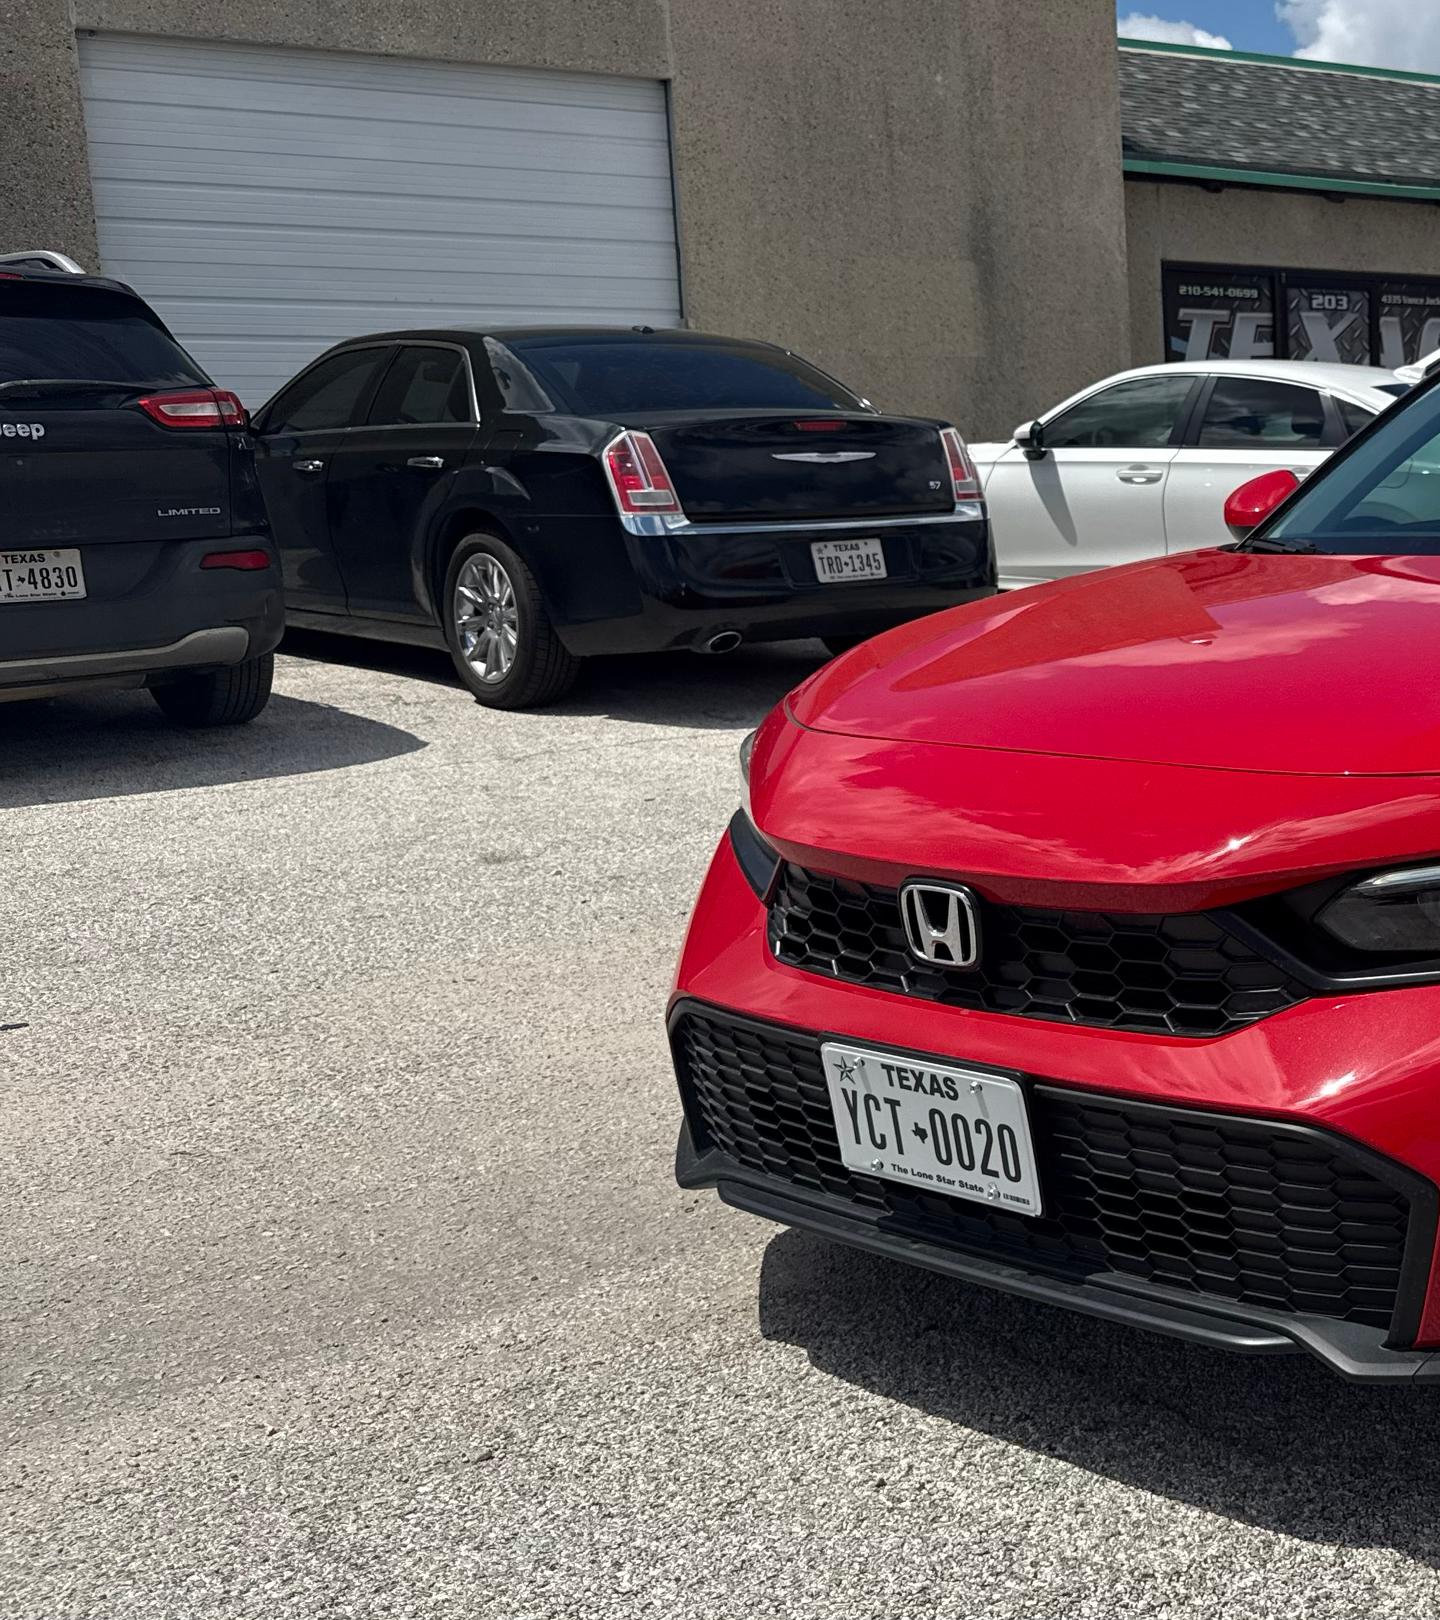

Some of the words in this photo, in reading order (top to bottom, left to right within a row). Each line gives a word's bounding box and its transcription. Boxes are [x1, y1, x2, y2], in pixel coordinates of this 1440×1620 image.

[1311, 294, 1348, 310] 203
[0, 423, 45, 440] eep
[157, 506, 221, 517] LIMITED
[833, 543, 860, 552] TEXAS
[1, 553, 46, 564] TEXAS
[881, 1063, 959, 1101] TEXAS
[891, 1163, 908, 1175] The
[911, 1168, 934, 1181] Lone
[936, 1174, 956, 1186] Star
[958, 1180, 985, 1193] State
